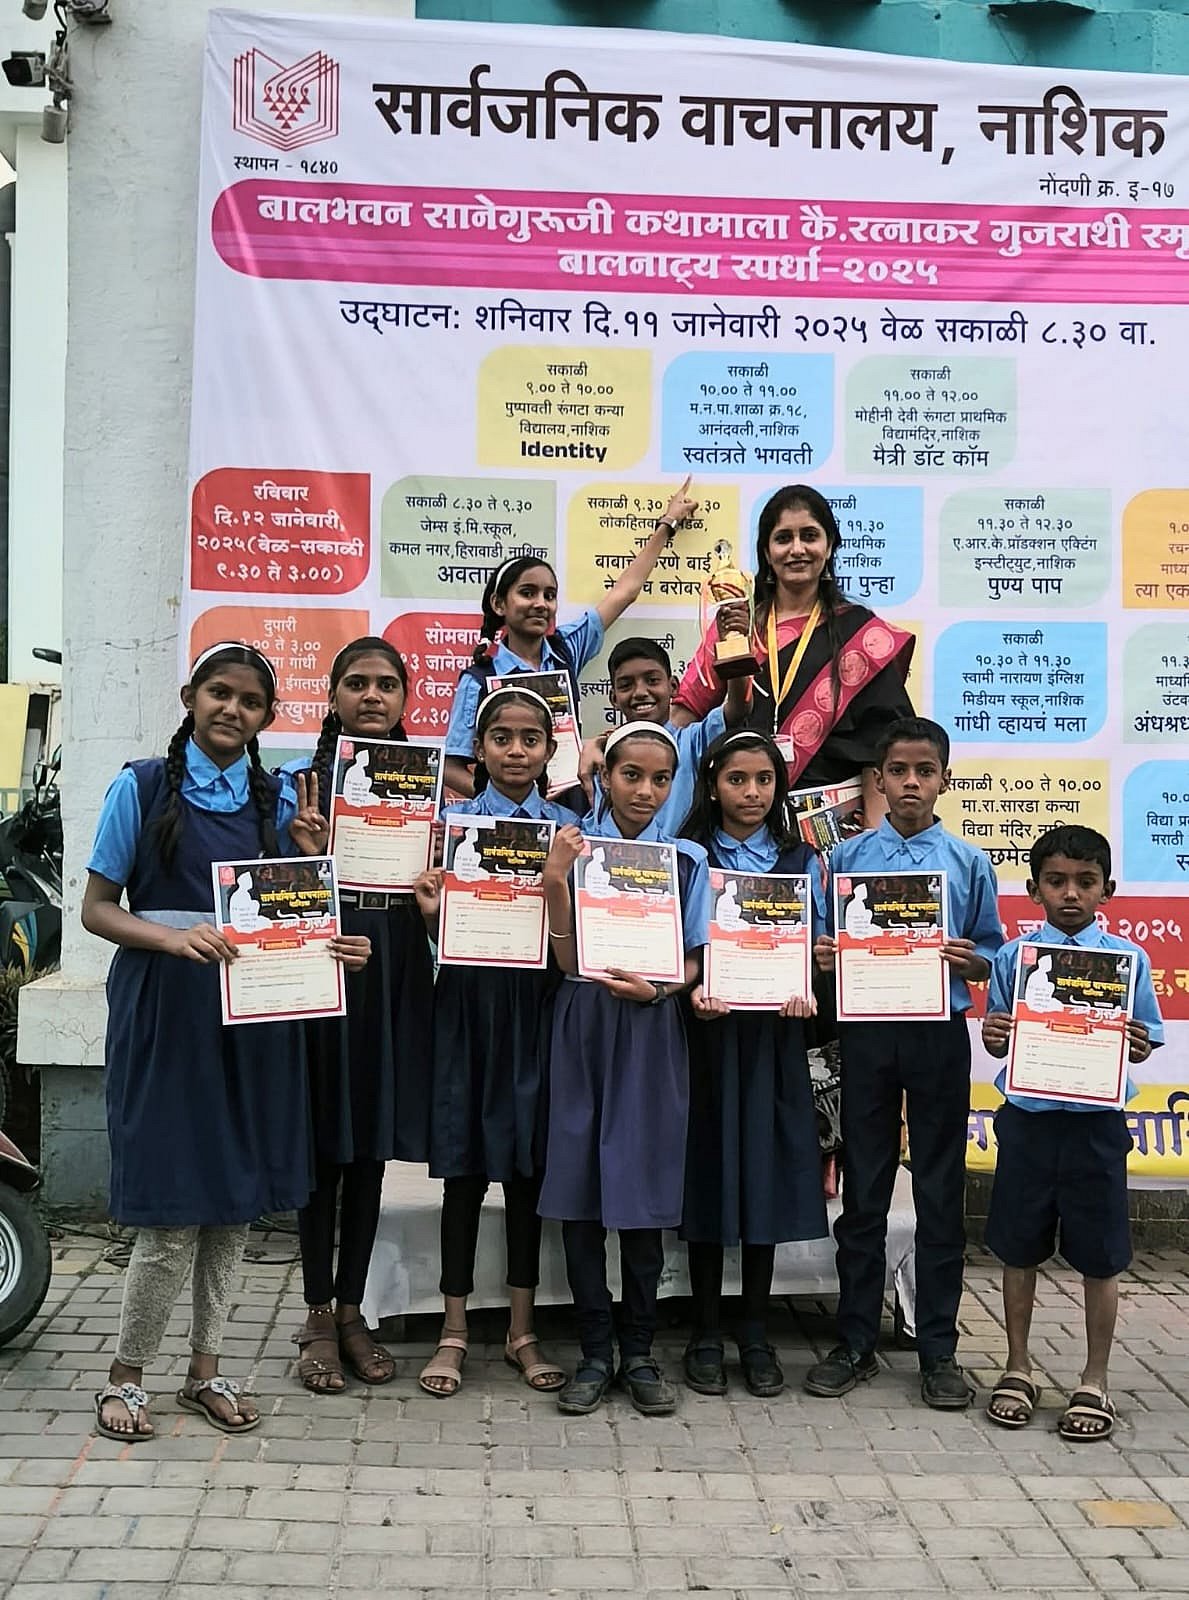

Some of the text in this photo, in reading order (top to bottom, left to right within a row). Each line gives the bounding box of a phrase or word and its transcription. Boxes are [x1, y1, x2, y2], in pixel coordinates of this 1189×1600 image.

[373, 64, 1168, 165] सार्वजनिक वाचनालय, नाशिक
[234, 155, 279, 172] स्थापन
[300, 159, 338, 174] १८४०
[1039, 172, 1175, 202] नोंदणी क्र. इ-१७
[257, 195, 413, 227] बालभवन
[624, 209, 790, 240] कथामाला
[990, 212, 1132, 257] गुजराथी
[557, 247, 938, 289] बालनाट्य स्पर्धा-२०२५
[474, 297, 572, 333] शनिवार
[585, 301, 658, 337] दि.११
[671, 303, 781, 339] जानेवारी
[794, 313, 868, 343] २०२५
[881, 307, 925, 341] वेळ
[936, 310, 1028, 345] सकाळी
[1041, 319, 1107, 347] ८.३०
[1119, 320, 1156, 345] वा.
[546, 361, 587, 376] सकाळी
[728, 362, 768, 377] सकाळी
[910, 365, 951, 380] सकाळी
[526, 379, 614, 396] ९.०० ते १०.००
[699, 381, 797, 397] १०.०० ते ११.००
[884, 386, 978, 402] ११.०० ते १२.००
[505, 398, 552, 417] पुष्पावती
[594, 404, 624, 417] कन्या
[855, 406, 892, 424] मोहीनी
[897, 406, 918, 424] देवी
[960, 408, 1007, 424] प्राथमिक
[521, 441, 608, 463] Identity
[683, 441, 813, 465] स्वतंत्रते भगवती
[873, 443, 989, 466] मैत्री डॉट कॉम
[253, 480, 309, 501] रविवार
[405, 493, 532, 513] सकाळी ८.३० ते ९.३०
[587, 495, 628, 510] सकाळी
[633, 499, 663, 513] ९.३०
[1004, 495, 1045, 511] सकाळी
[214, 504, 346, 532] दि.१२ जानेवारी,
[420, 516, 448, 533] जेम्स
[847, 520, 884, 533] ११.३०
[977, 514, 1073, 531] ११.३० ते १२.३०
[389, 542, 421, 556] कमल
[1061, 535, 1097, 551] एक्टिंग
[686, 552, 712, 573] बाई
[216, 560, 344, 584] ९.३० ते ३.००)
[859, 576, 896, 598] पुन्हा
[988, 577, 1063, 600] पुण्य पाप
[1134, 583, 1160, 598] त्या
[264, 616, 297, 636] दुपारी
[275, 636, 285, 651] ते
[290, 640, 321, 654] ३.००
[1002, 630, 1044, 645] सकाळी
[289, 652, 317, 670] गांधी
[975, 651, 1071, 668] १०.३० ते ११.३०
[962, 669, 1084, 687] स्वामी नारायण इंग्लिश
[963, 690, 1005, 706] मिडीयम
[954, 710, 1087, 735] गांधी व्हायचं मला
[1000, 777, 1034, 793] ९.००
[1040, 773, 1051, 791] ते
[1059, 778, 1101, 793] १०.००
[962, 799, 1080, 814] मा.रा.सारडा कन्या
[962, 819, 994, 837] विद्या
[1147, 811, 1174, 827] विद्या
[1151, 830, 1184, 846] मराठी
[1119, 919, 1183, 943] २०२५
